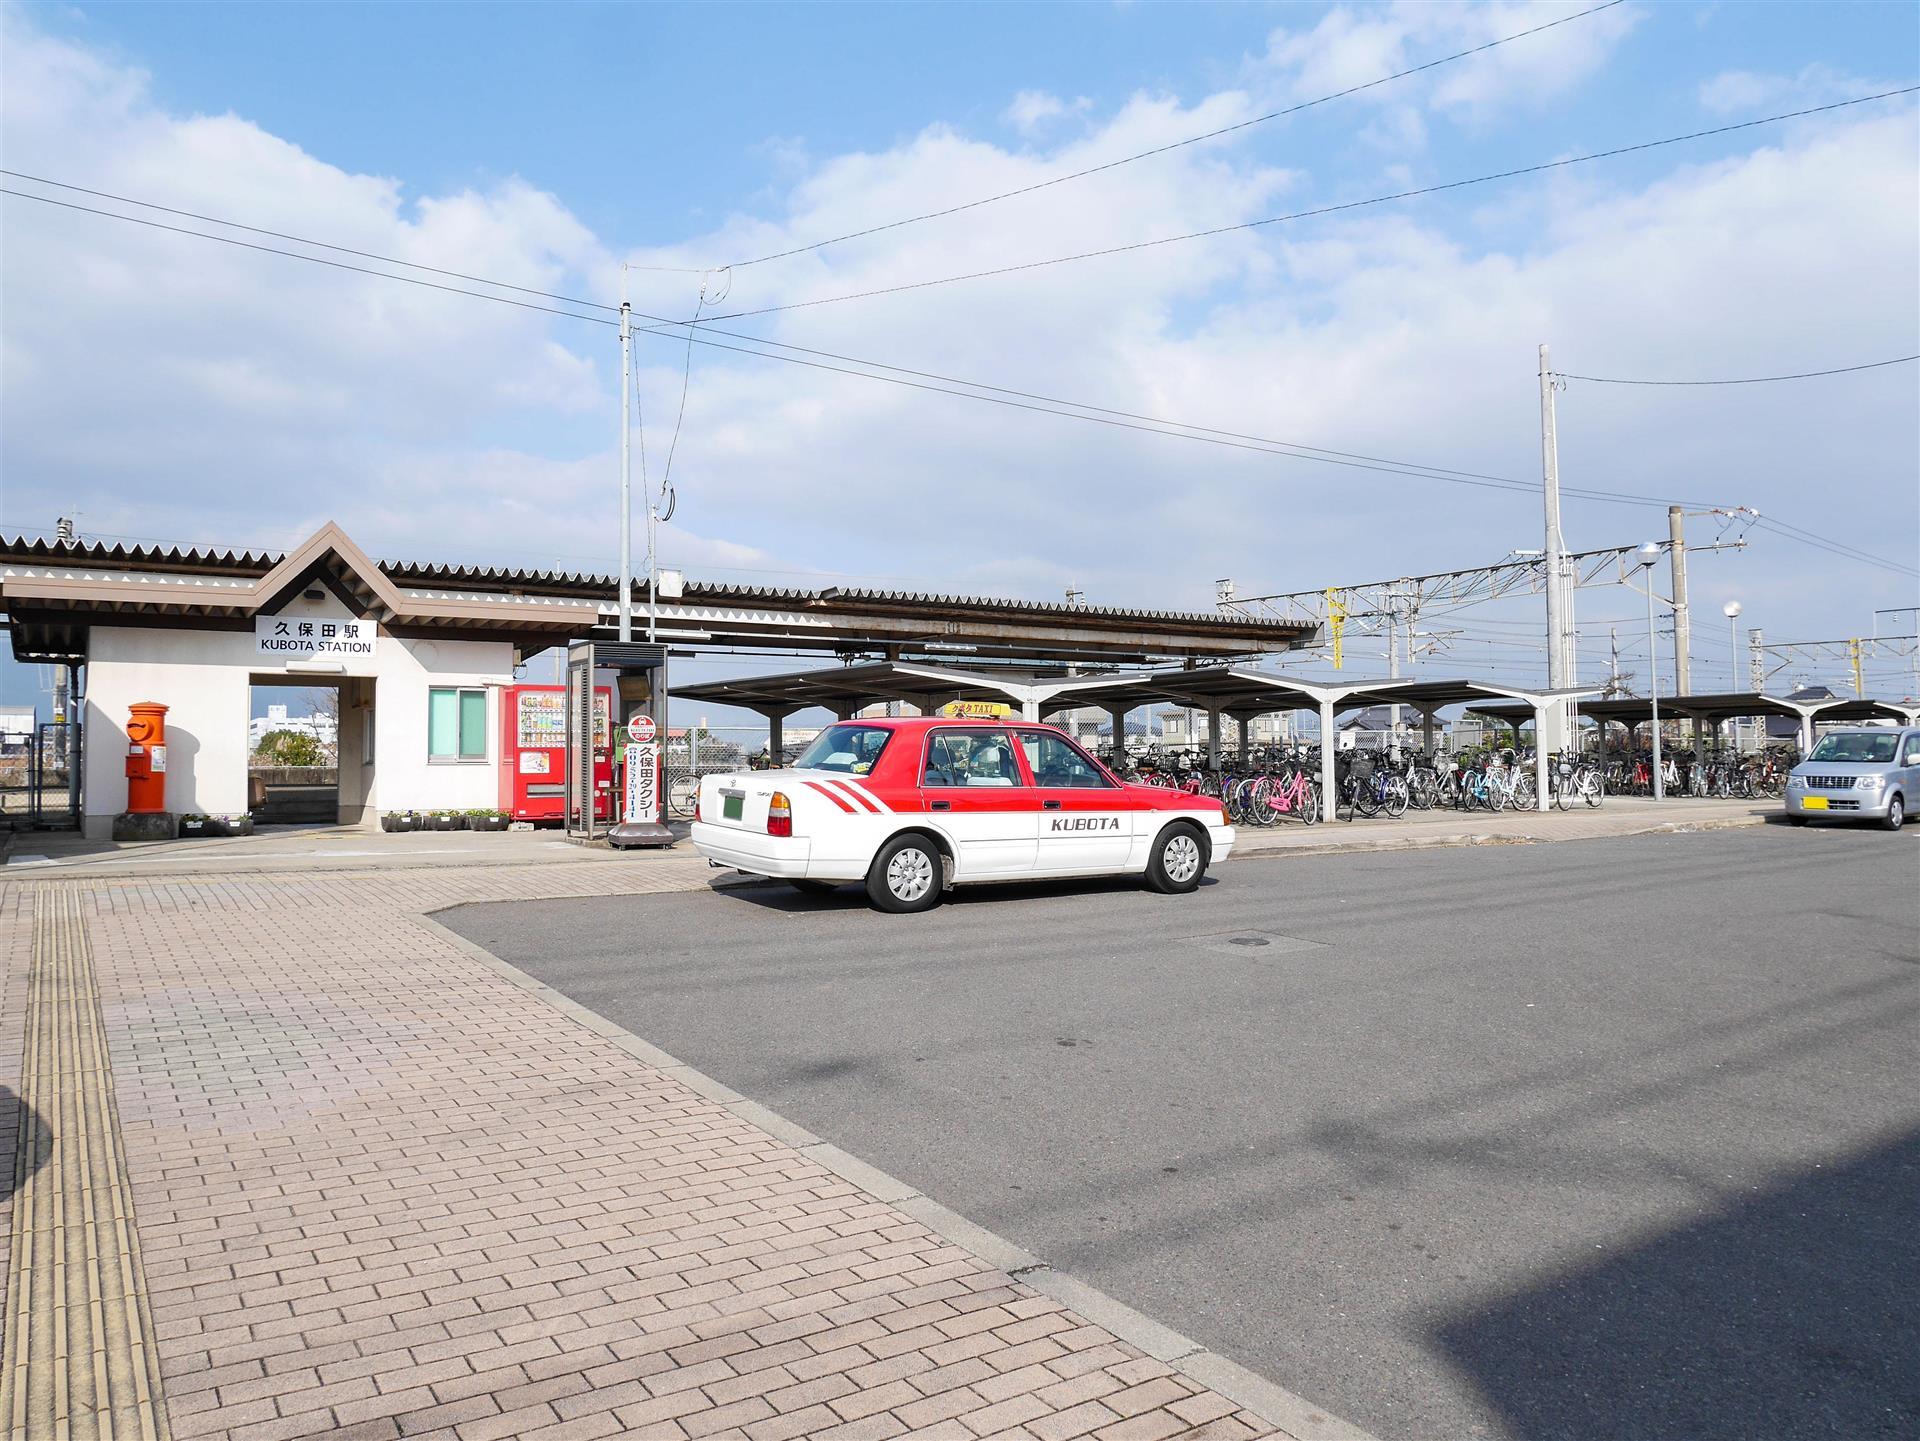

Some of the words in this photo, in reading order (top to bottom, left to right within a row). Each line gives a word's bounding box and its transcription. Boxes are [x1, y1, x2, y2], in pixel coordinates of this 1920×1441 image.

[275, 621, 359, 638] 久保田駅
[261, 639, 314, 652] KUBOTA
[318, 641, 371, 653] STATION
[952, 704, 972, 712] クボタ
[974, 704, 993, 713] TAXI
[640, 747, 654, 818] 久保田タクシー
[1051, 818, 1119, 831] KUBOTA
